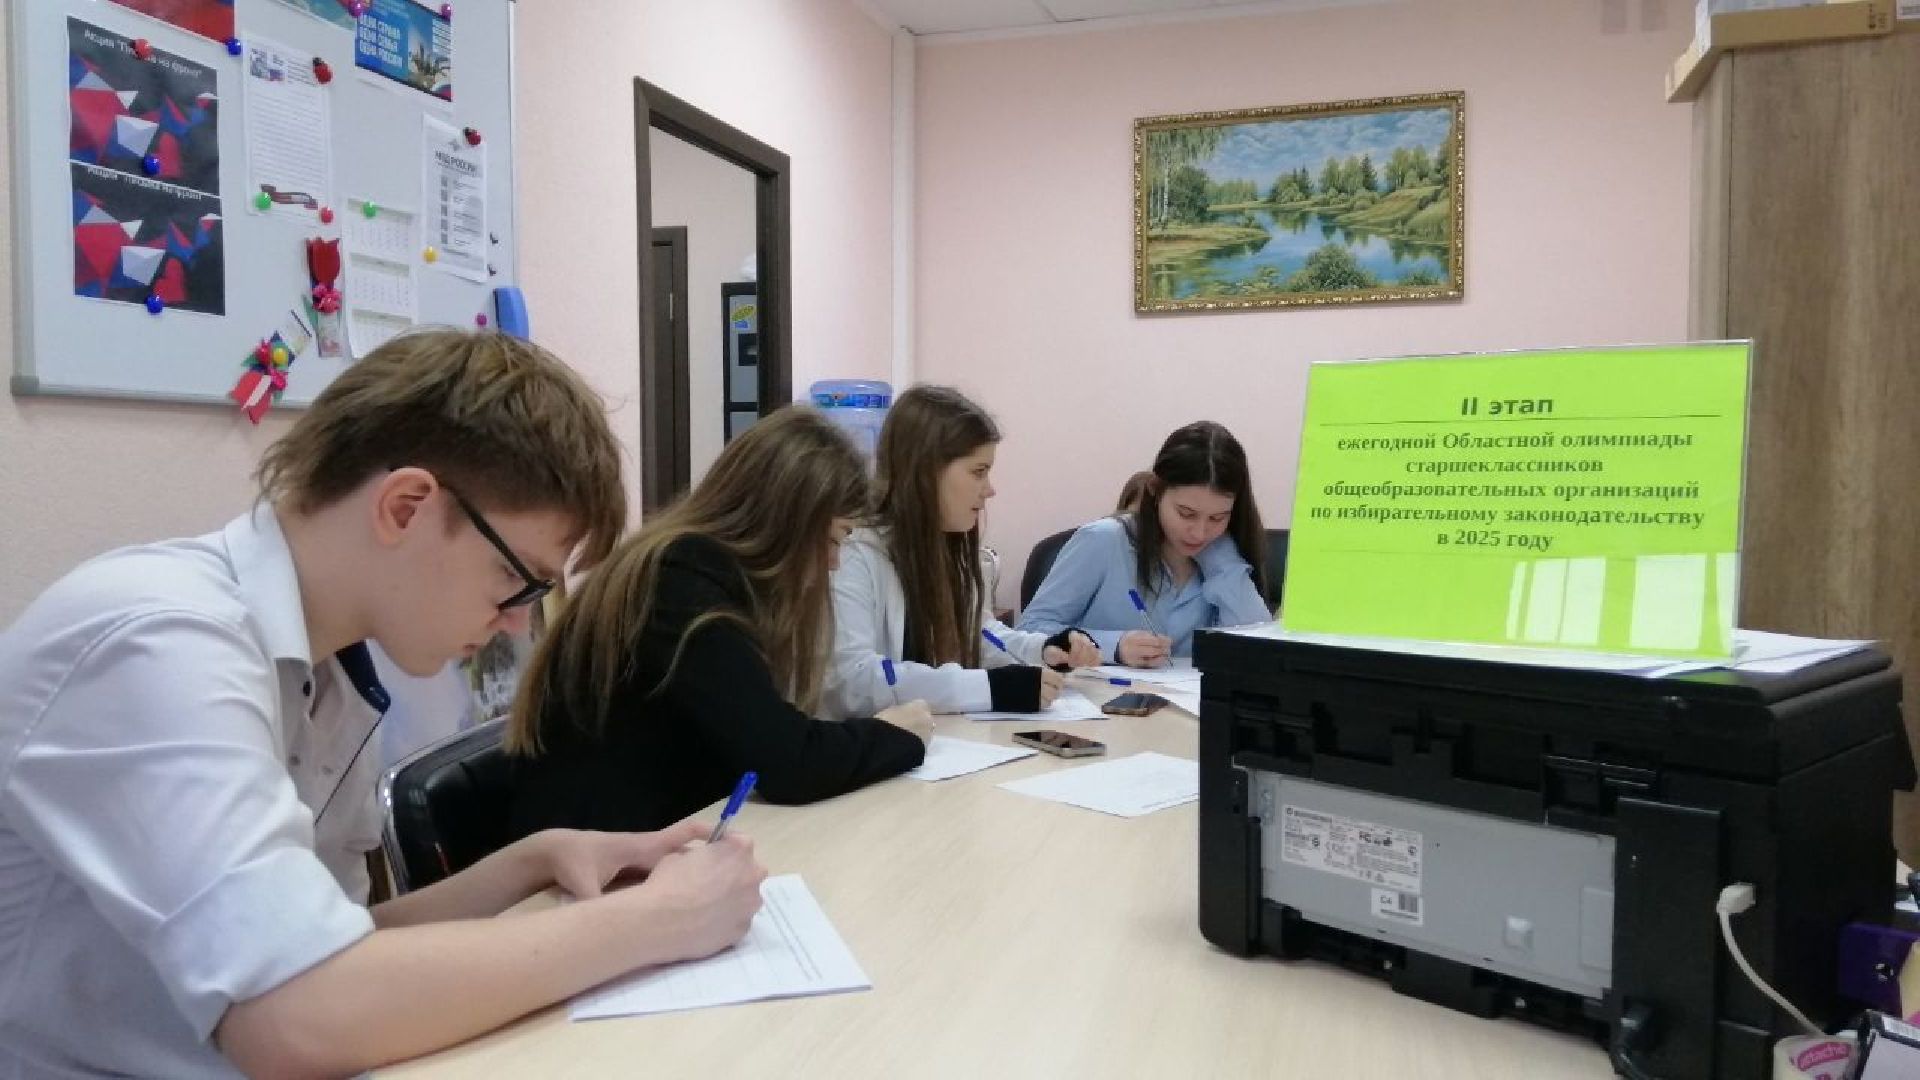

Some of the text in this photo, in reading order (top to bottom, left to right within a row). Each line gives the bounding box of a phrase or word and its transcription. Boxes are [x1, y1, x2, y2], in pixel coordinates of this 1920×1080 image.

[1488, 399, 1553, 416] этап
[1337, 431, 1693, 451] ежегодной Областной олимпиады
[1406, 458, 1604, 476] старшеклассников
[1323, 480, 1700, 502] общеобразовательных организаций
[1310, 504, 1705, 530] по избирательному законодательству
[1437, 529, 1553, 553] в 2025 году
